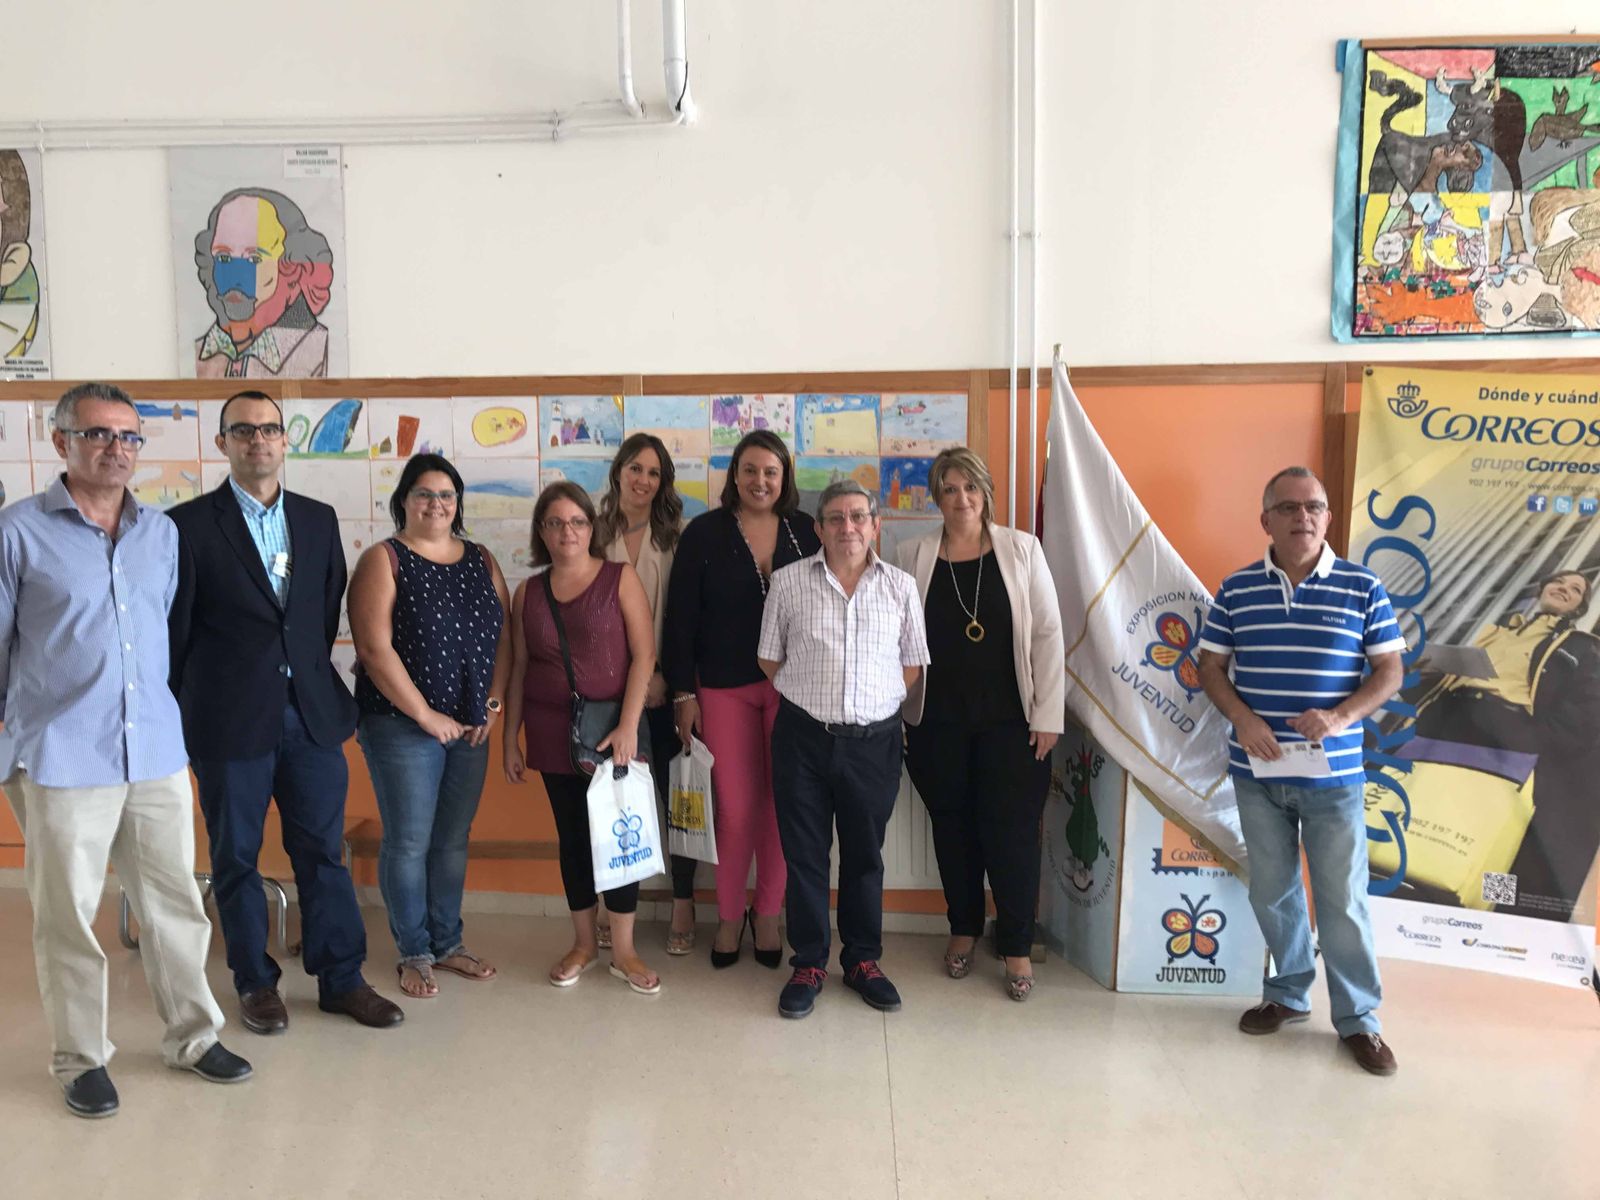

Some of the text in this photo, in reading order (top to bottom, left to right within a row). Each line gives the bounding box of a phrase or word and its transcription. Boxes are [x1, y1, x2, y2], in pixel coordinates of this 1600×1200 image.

[1479, 387, 1600, 406] Dónde y cuánd
[1421, 407, 1600, 447] CORREOS
[1126, 591, 1186, 635] EXPOSICION
[1111, 661, 1196, 734] JUVENTUD
[609, 847, 653, 869] JUVENTUD
[1156, 966, 1226, 984] JUVENTUD
